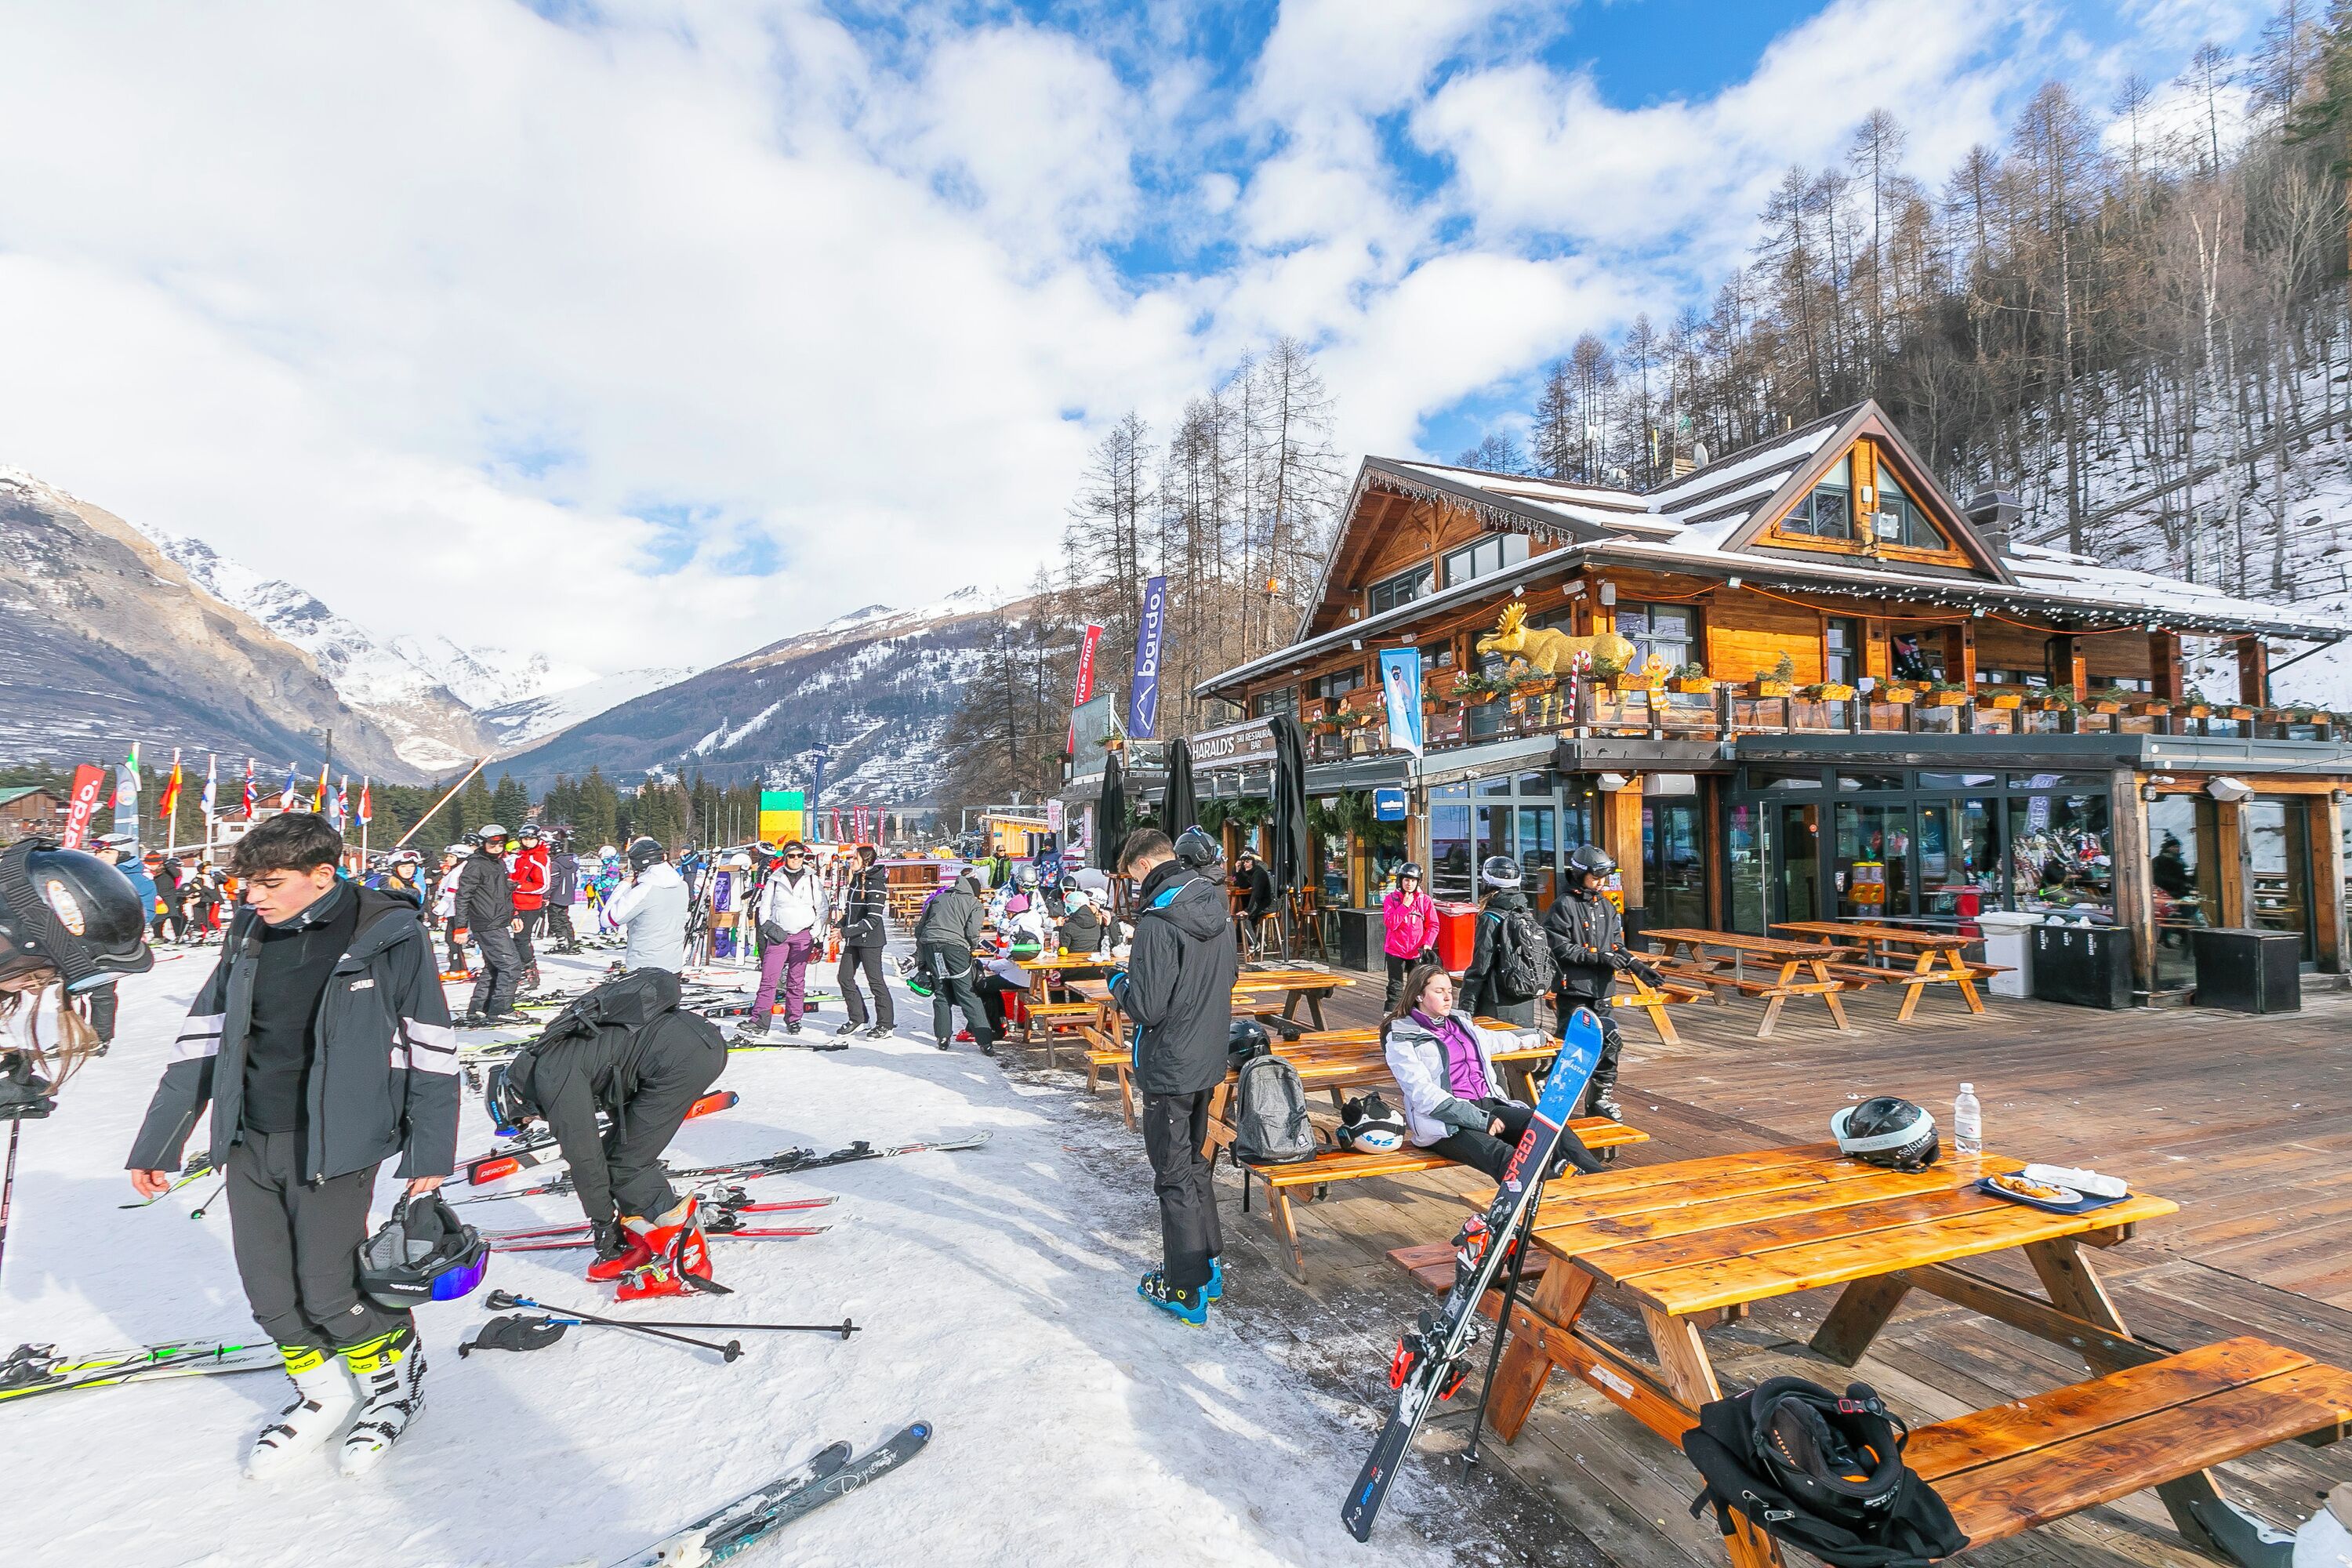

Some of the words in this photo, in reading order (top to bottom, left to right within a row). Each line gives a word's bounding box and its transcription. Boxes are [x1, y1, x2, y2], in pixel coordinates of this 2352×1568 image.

[1138, 586, 1162, 677] bardo.
[1078, 637, 1094, 704] rdo.shop
[1192, 735, 1235, 760] HARALD'S
[1236, 735, 1245, 743] SKI
[1245, 728, 1275, 742] RESTAURA
[1250, 739, 1262, 750] BAR
[64, 780, 99, 848] ardo.
[1559, 1056, 1587, 1076] DASTAR
[1503, 1129, 1537, 1181] SPEED
